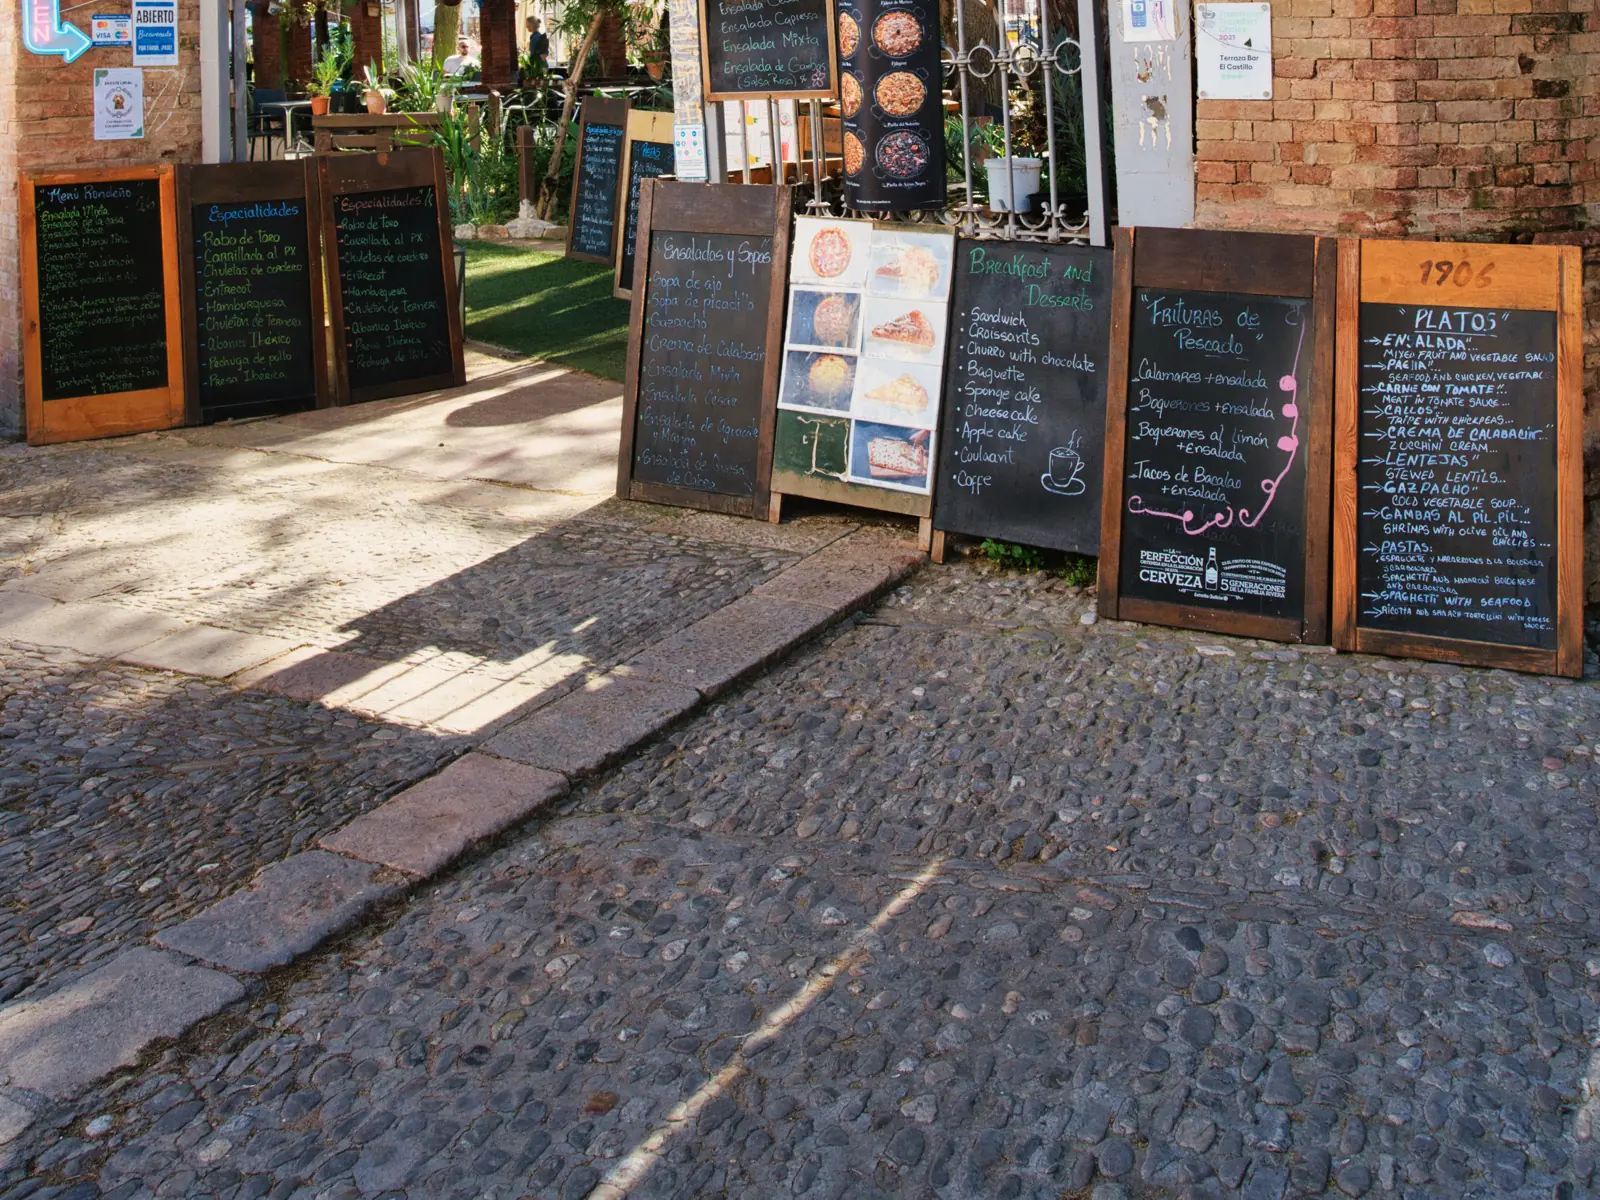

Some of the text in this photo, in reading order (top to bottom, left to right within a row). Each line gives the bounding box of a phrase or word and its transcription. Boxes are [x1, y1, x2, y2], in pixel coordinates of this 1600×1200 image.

[136, 10, 174, 23] ABIERTO
[719, 1, 763, 15] Ensalada
[721, 15, 772, 33] Ensalada
[723, 26, 819, 52] Ensalada Mixta
[724, 58, 772, 74] Ensalada
[775, 60, 785, 71] de
[208, 202, 299, 228] Especialidades
[203, 230, 236, 246] Rabo
[240, 228, 254, 244] de
[267, 245, 278, 259] al
[204, 262, 248, 277] Chuletas
[251, 264, 263, 275] de
[1419, 260, 1495, 288] 1906
[205, 278, 252, 297] Entrecot
[685, 270, 700, 289] de
[971, 306, 1027, 327] Sandwich
[1237, 306, 1260, 326] de
[1414, 308, 1497, 332] PLATOS
[968, 322, 1040, 345] Croissants
[1173, 327, 1243, 354] Pescado
[1010, 348, 1036, 364] with
[1042, 352, 1095, 372] chocolate
[1383, 349, 1415, 359] MIXED
[1417, 350, 1448, 360] FRUIT
[1450, 352, 1466, 361] AND
[1470, 353, 1518, 363] VEGETABLE
[968, 360, 1025, 384] Baguette
[1433, 372, 1451, 381] AND
[964, 381, 1010, 405] Sponge
[1421, 383, 1440, 392] CON
[1424, 415, 1449, 425] WITH
[962, 421, 994, 443] Apple
[1138, 421, 1205, 445] Boquerones
[1210, 424, 1223, 443] al
[1387, 426, 1441, 439] CREMA
[1448, 427, 1464, 439] DE
[957, 470, 992, 494] Coffe
[1134, 460, 1242, 489] Tacos de Bacalao
[1386, 468, 1434, 480] STEWED
[1392, 495, 1418, 506] COLD
[1424, 497, 1484, 509] VEGETABLE
[1380, 506, 1465, 523] GAMBAS AL
[1433, 524, 1455, 536] WITH
[1459, 525, 1487, 537] OLIVE
[1492, 526, 1507, 537] OIL
[1511, 529, 1528, 538] AND
[1140, 550, 1203, 567] PERFECCIÓN
[1139, 569, 1203, 588] CERVEZA
[1220, 579, 1286, 593] 5 GENERACIONES
[1266, 590, 1285, 598] RIVERA
[1380, 590, 1531, 607] SPAGHETTI WITH SEAFOOD
